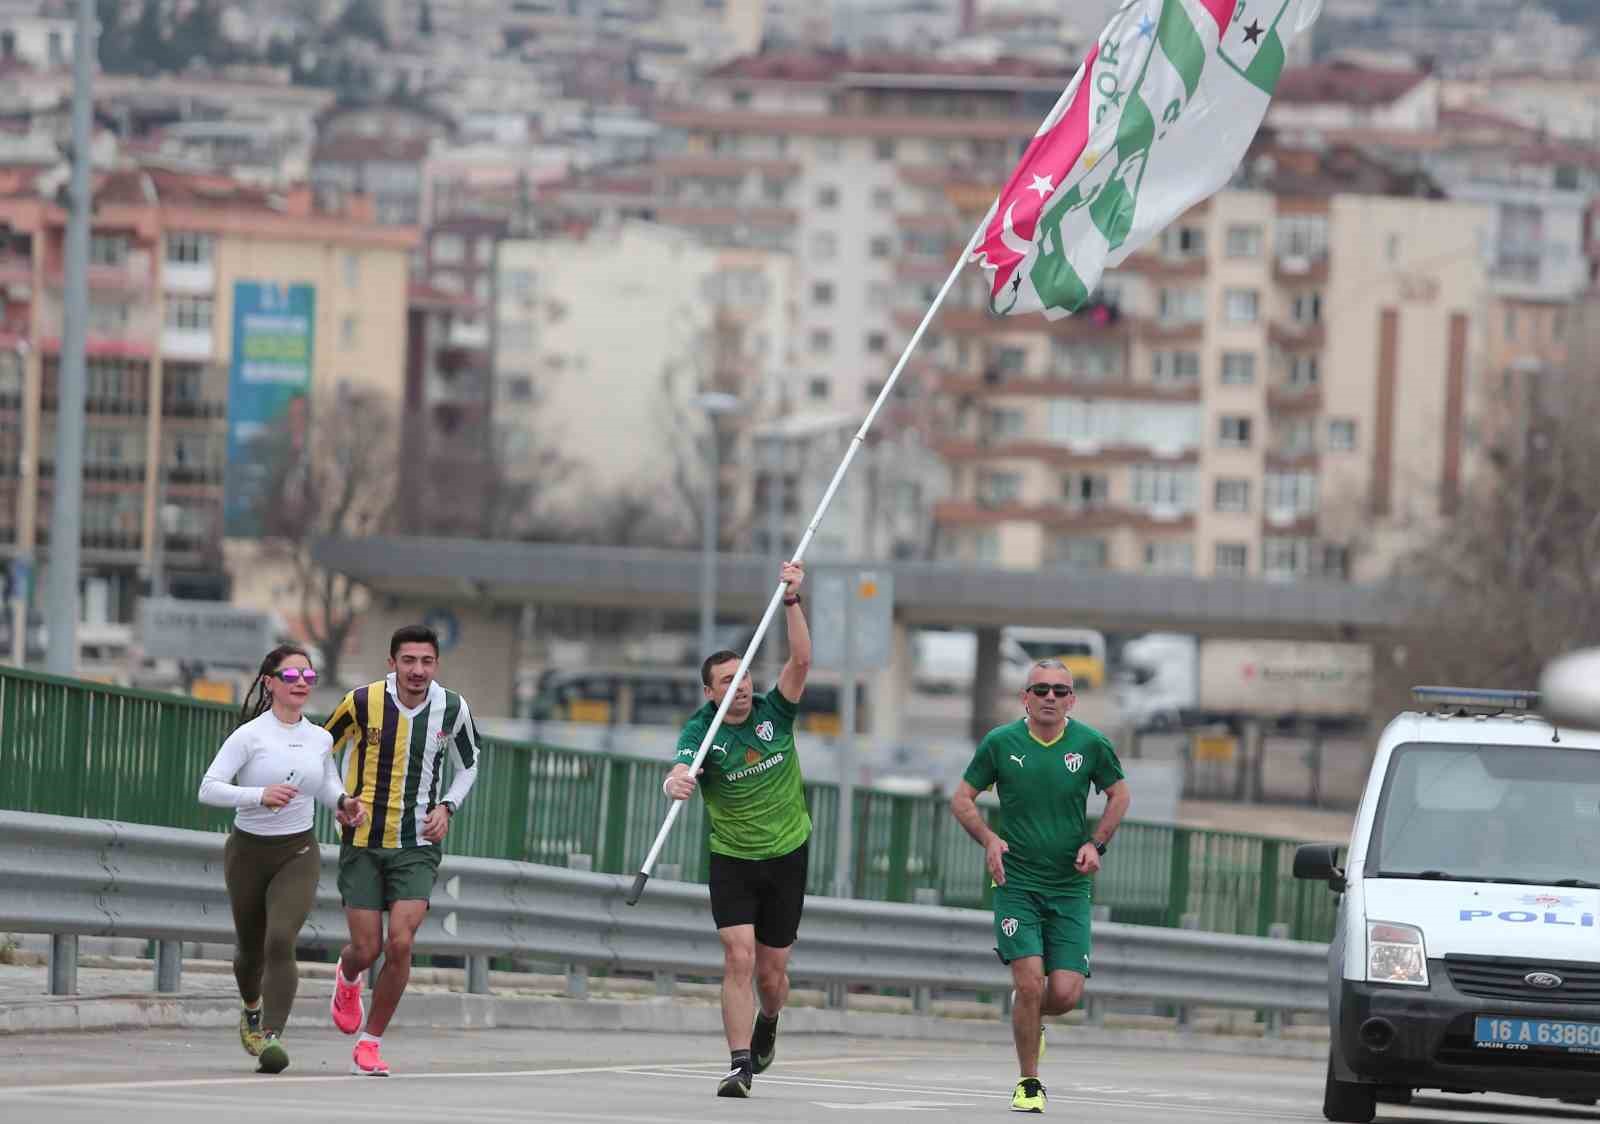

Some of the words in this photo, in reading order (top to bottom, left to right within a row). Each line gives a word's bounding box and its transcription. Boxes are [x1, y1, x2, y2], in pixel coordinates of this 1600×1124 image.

[726, 752, 784, 782] warmhaus
[1459, 909, 1600, 928] POLİ
[1490, 1019, 1512, 1041] 16
[1519, 1021, 1531, 1041] A
[1537, 1022, 1600, 1046] 63860
